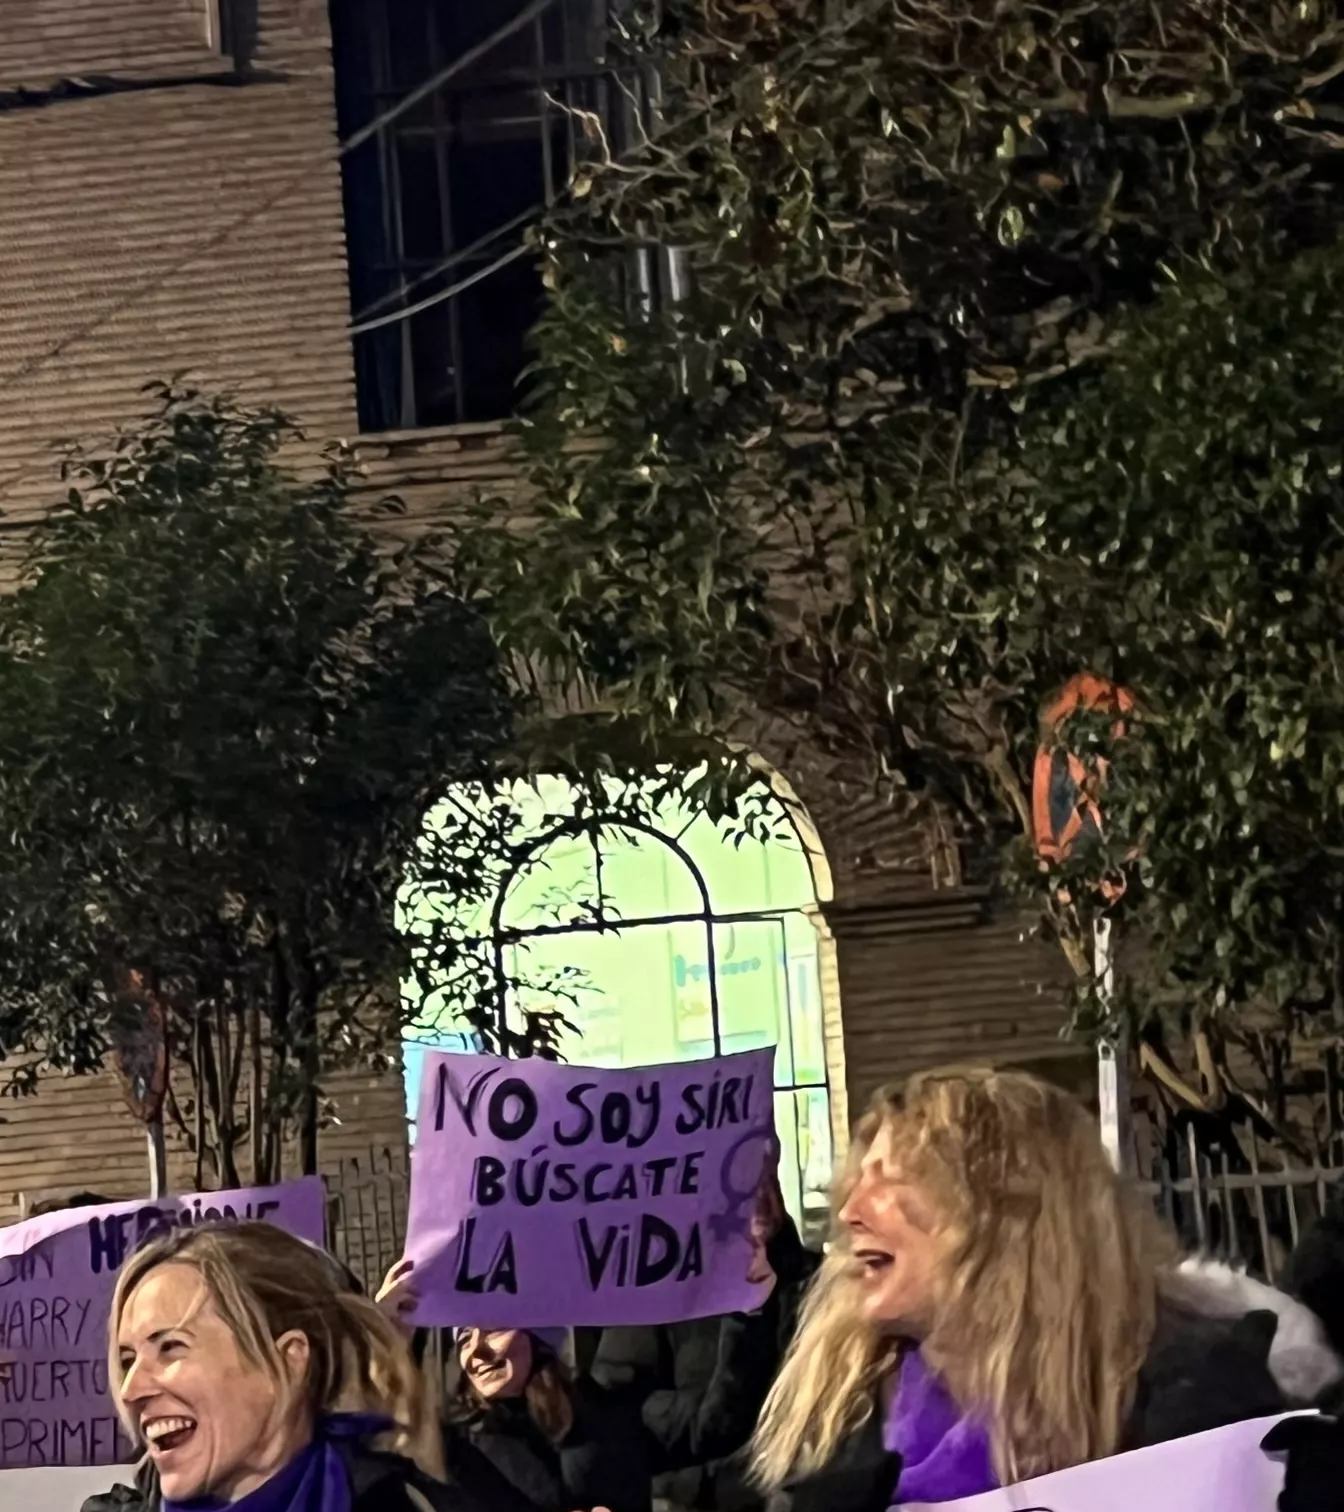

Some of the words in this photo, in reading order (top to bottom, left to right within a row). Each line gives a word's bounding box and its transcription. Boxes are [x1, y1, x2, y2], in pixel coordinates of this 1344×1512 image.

[433, 1062, 540, 1142] NO
[553, 1080, 660, 1148] SOY
[470, 1145, 706, 1206] BÚSCATE
[453, 1215, 519, 1295] LA
